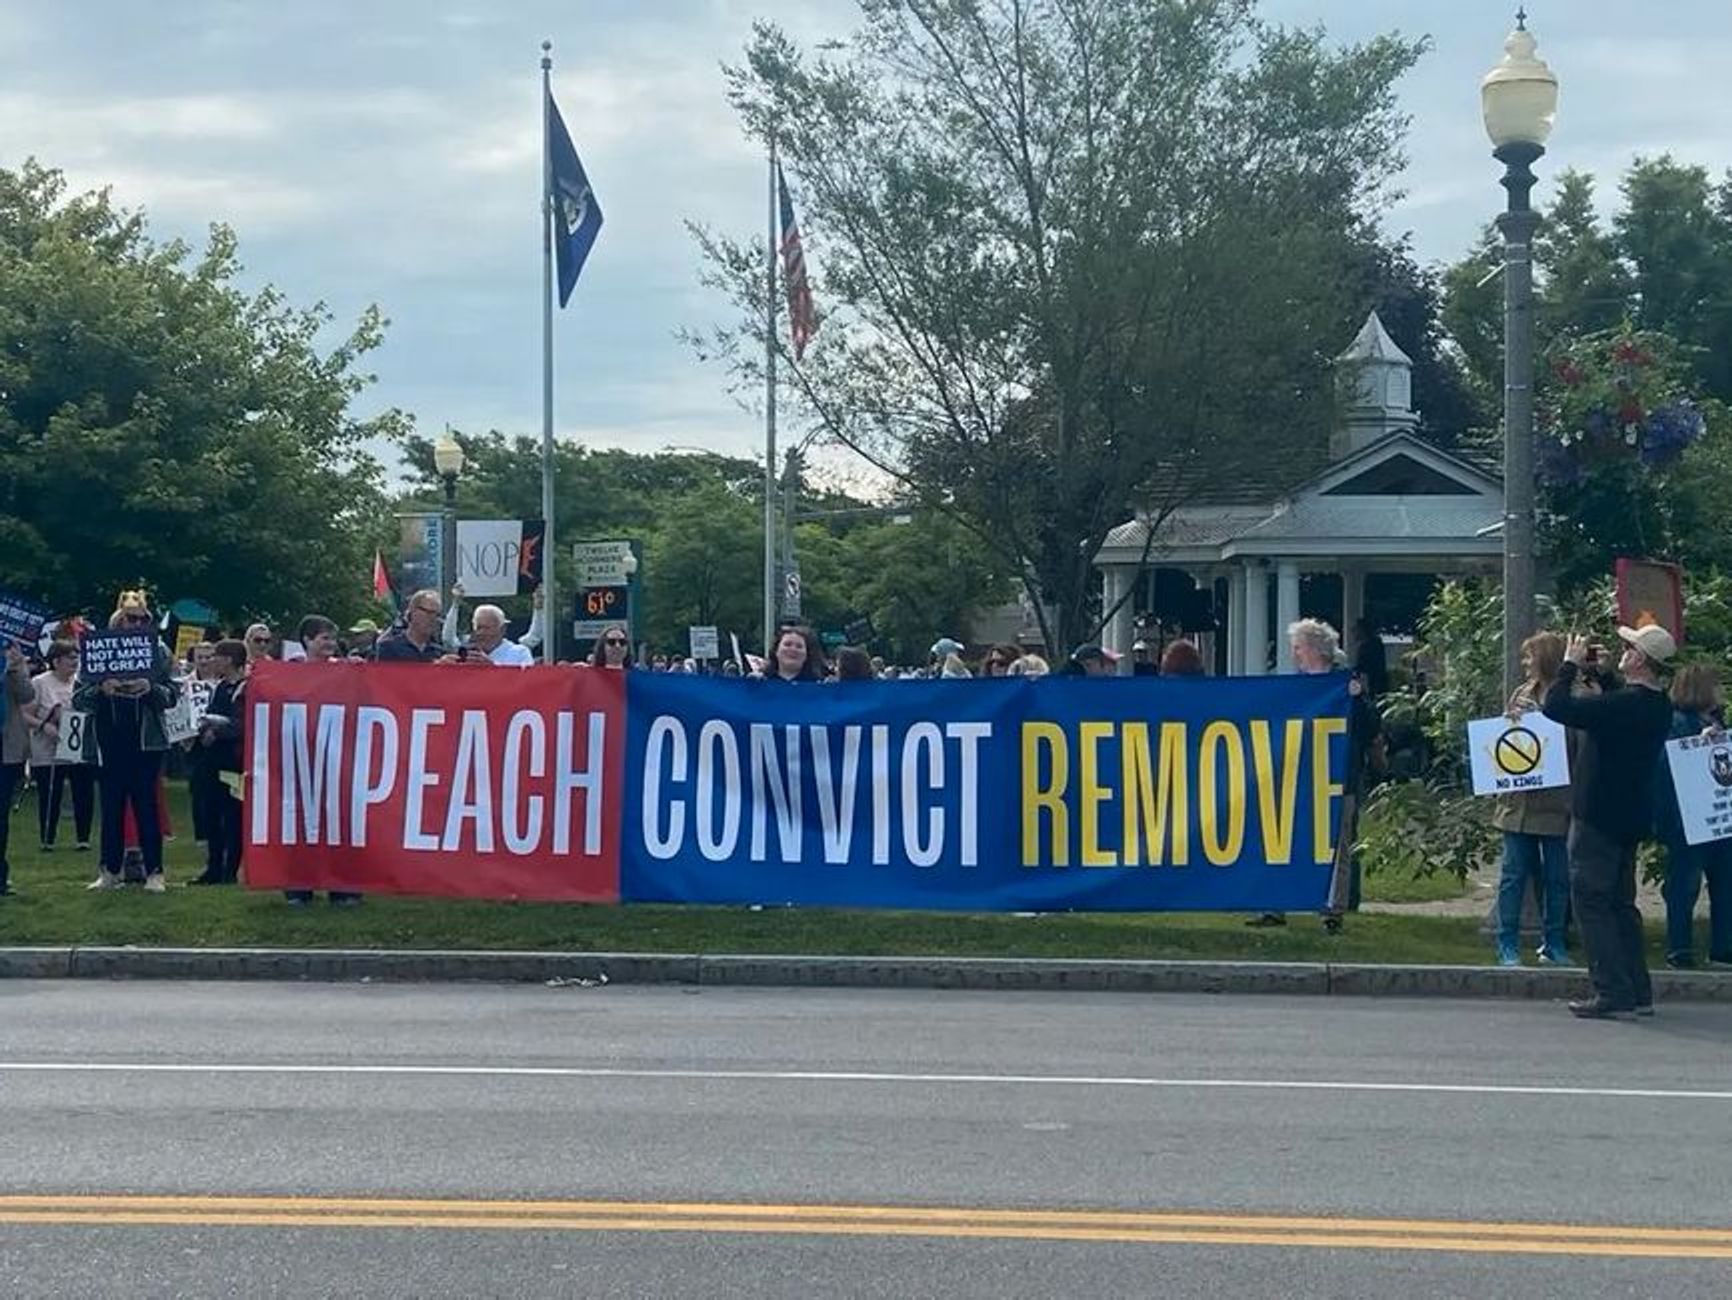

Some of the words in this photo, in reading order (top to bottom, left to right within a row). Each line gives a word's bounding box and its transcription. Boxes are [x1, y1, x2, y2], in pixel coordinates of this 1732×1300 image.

[86, 637, 118, 649] HATE
[120, 635, 151, 648] WILL
[86, 650, 114, 661] NOT
[117, 648, 151, 660] MAKE
[88, 662, 106, 673] US
[108, 658, 153, 672] GREAT
[68, 715, 81, 751] 8
[252, 703, 606, 856] IMPEACH
[641, 714, 993, 867] CONVICT
[1021, 718, 1348, 867] REMOVE
[1496, 777, 1510, 789] NO
[1512, 774, 1543, 787] KINGS
